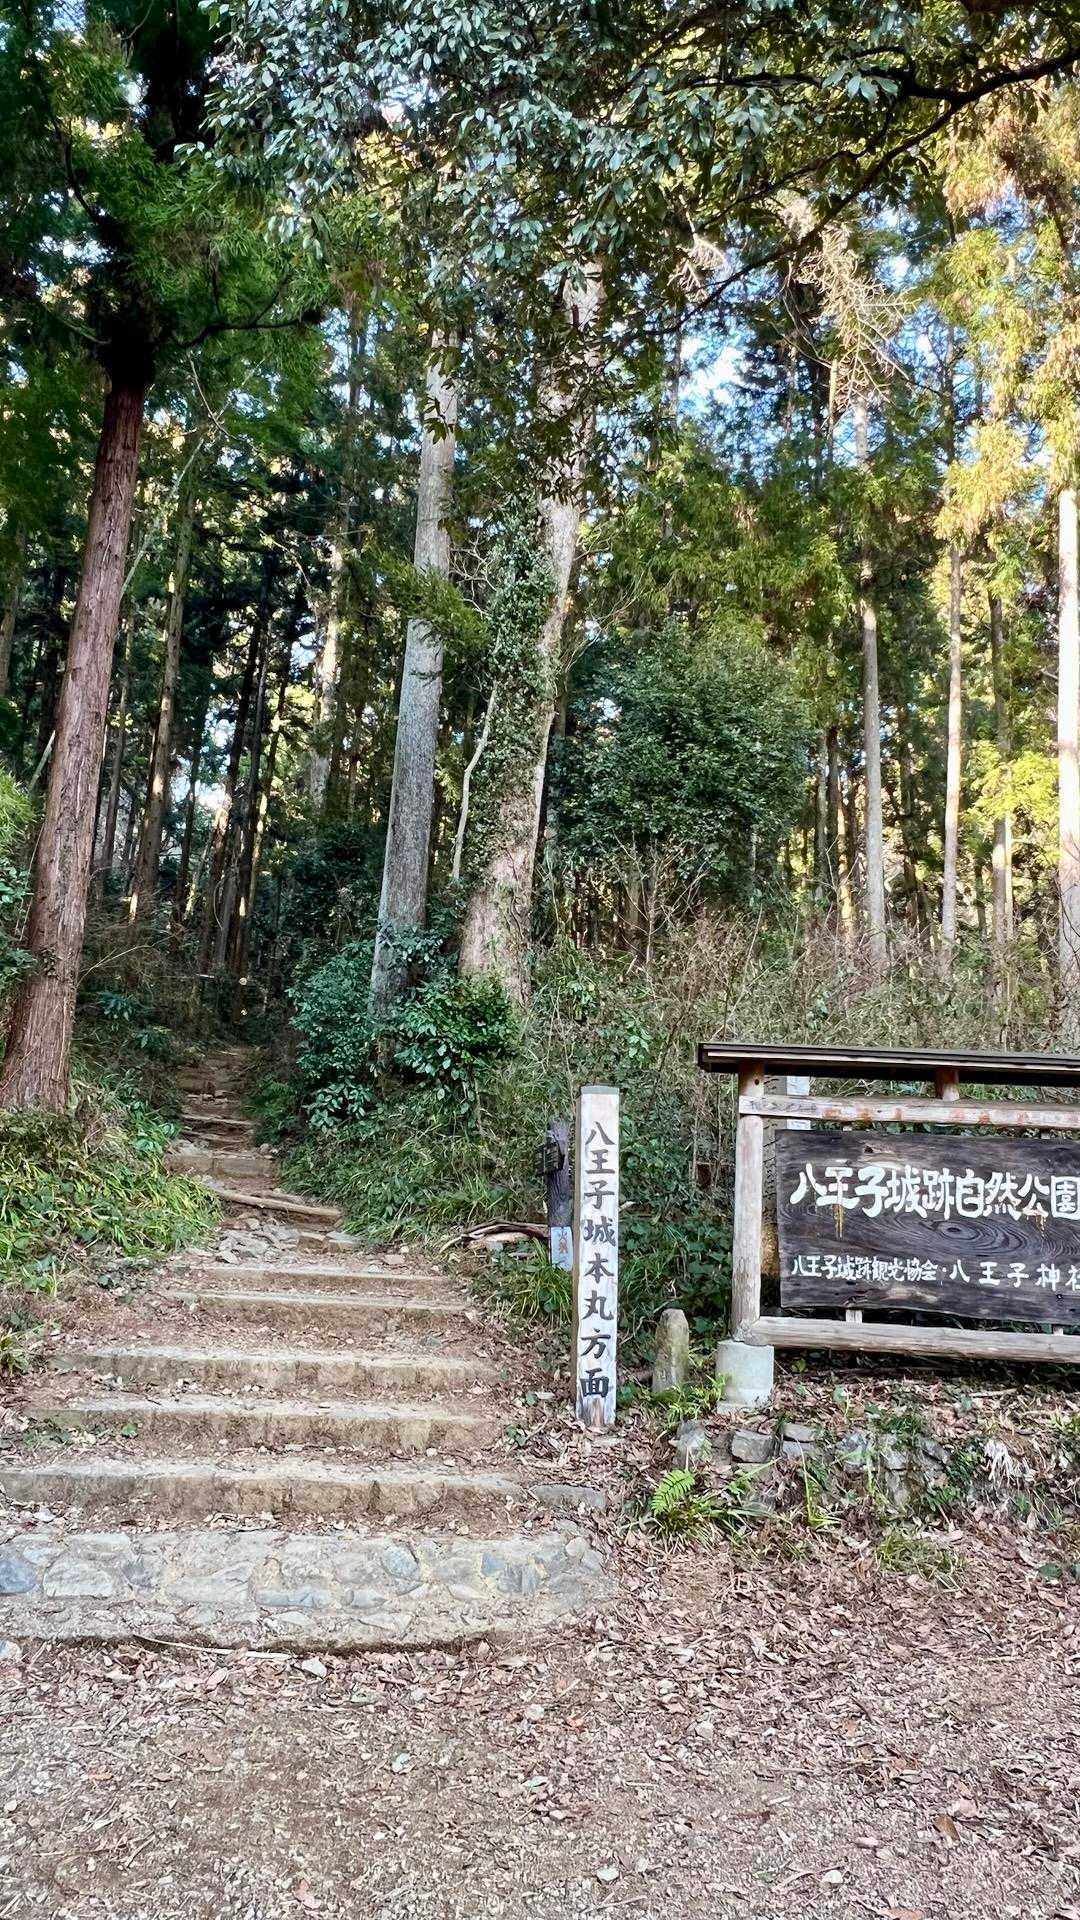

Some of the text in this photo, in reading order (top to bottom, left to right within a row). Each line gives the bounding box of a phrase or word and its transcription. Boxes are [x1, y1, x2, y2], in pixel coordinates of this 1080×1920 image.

[580, 1121, 616, 1398] 八王子城本丸方面
[790, 1162, 1080, 1220] 八王子城跡自然公園
